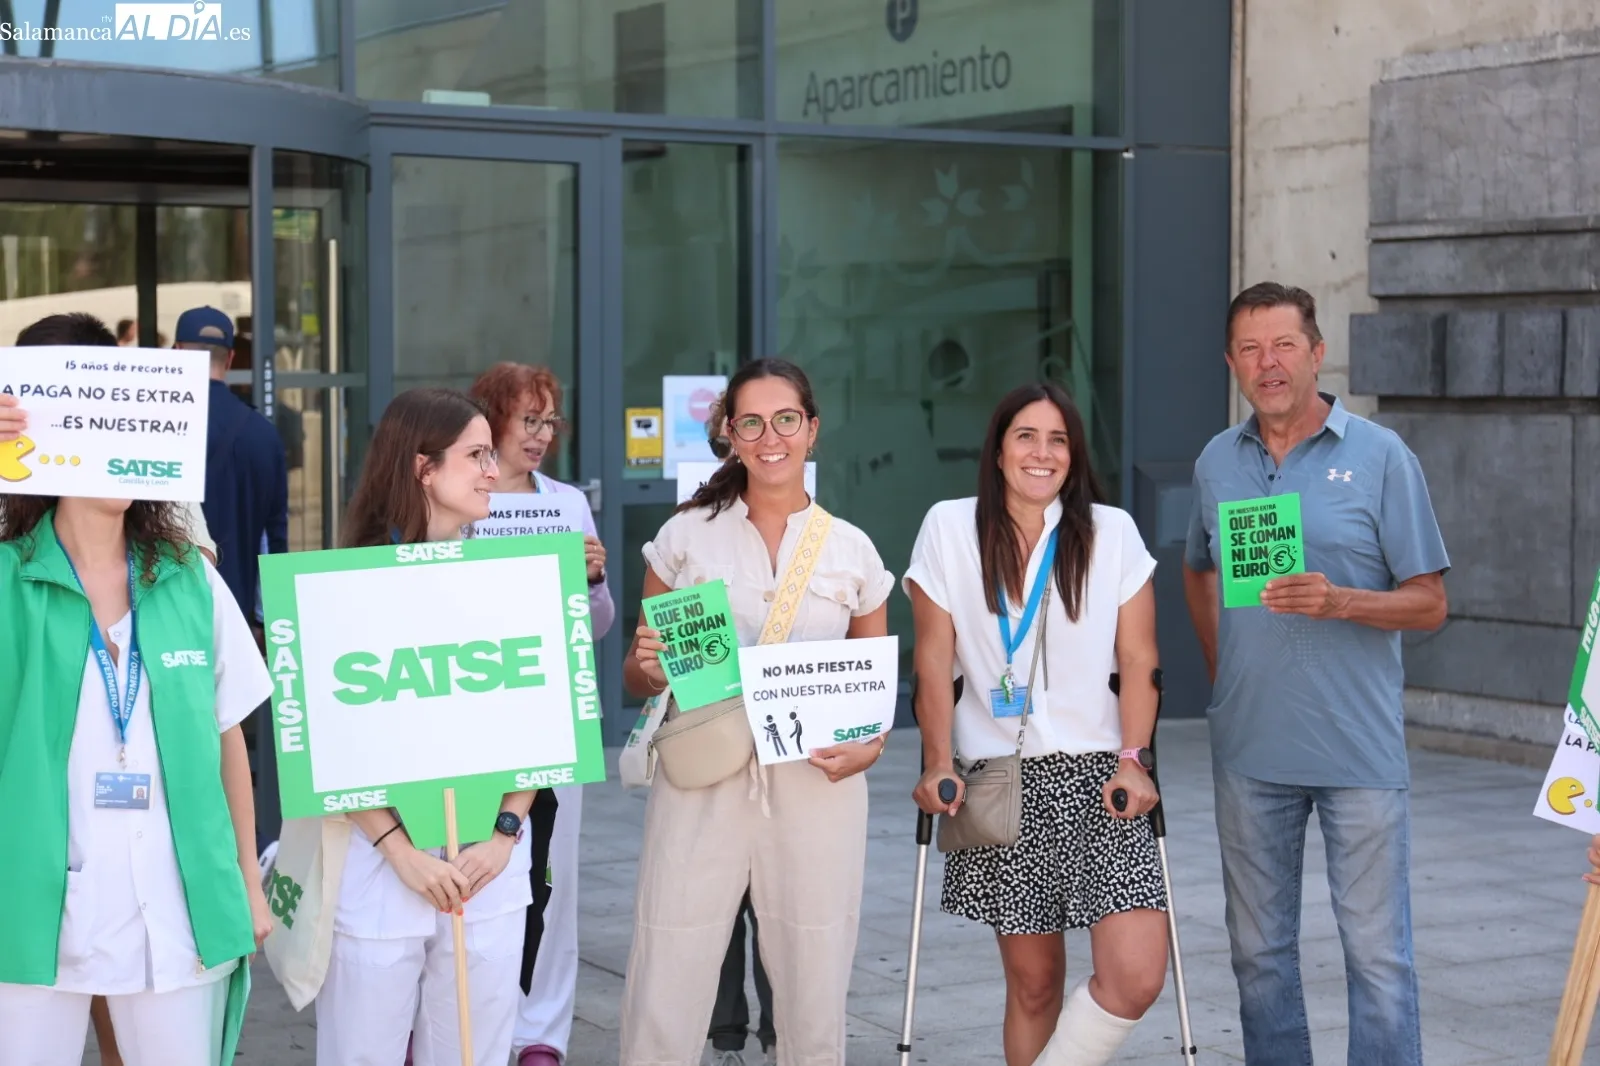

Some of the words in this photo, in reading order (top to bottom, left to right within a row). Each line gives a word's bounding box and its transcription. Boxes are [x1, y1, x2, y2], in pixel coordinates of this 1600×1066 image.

[802, 44, 1012, 124] Aparcamiento
[65, 360, 76, 370] 15
[81, 361, 108, 371] años
[113, 361, 127, 372] de
[131, 364, 183, 375] recortes
[20, 383, 72, 398] PAGA
[78, 386, 106, 400] NO
[111, 387, 131, 402] ES
[136, 388, 195, 404] EXTRA
[89, 416, 188, 437] NUESTRA!!
[107, 457, 183, 479] SATSE
[515, 509, 561, 519] FIESTAS
[1259, 503, 1277, 512] EXTRA
[483, 526, 534, 536] NUESTRA
[1229, 515, 1256, 531] QUE
[1258, 511, 1278, 528] NO
[1230, 532, 1247, 547] SE
[1249, 525, 1296, 545] COMAN
[395, 540, 464, 563] SATSE
[1231, 548, 1246, 562] NI
[1249, 545, 1269, 561] UN
[1232, 561, 1270, 578] EURO
[653, 608, 682, 627] QUE
[683, 602, 705, 620] NO
[677, 612, 727, 638] COMAN
[160, 649, 208, 669] SATSE
[567, 593, 598, 721] SATSE
[663, 644, 678, 661] NI
[679, 638, 701, 656] UN
[332, 635, 546, 706] SATSE
[668, 654, 704, 678] EURO
[762, 666, 782, 678] NO
[785, 663, 814, 676] MAS
[817, 659, 873, 673] FIESTAS
[97, 649, 120, 720] ENFERMERO/A
[124, 651, 139, 720] ENFERMERO/A
[269, 618, 304, 753] SATSE
[753, 689, 778, 701] CON
[781, 683, 842, 699] NUESTRA
[844, 680, 886, 694] EXTRA
[833, 722, 882, 742] SATSE
[1565, 734, 1582, 749] LA
[514, 767, 575, 789] SATSE
[323, 789, 388, 812] SATSE
